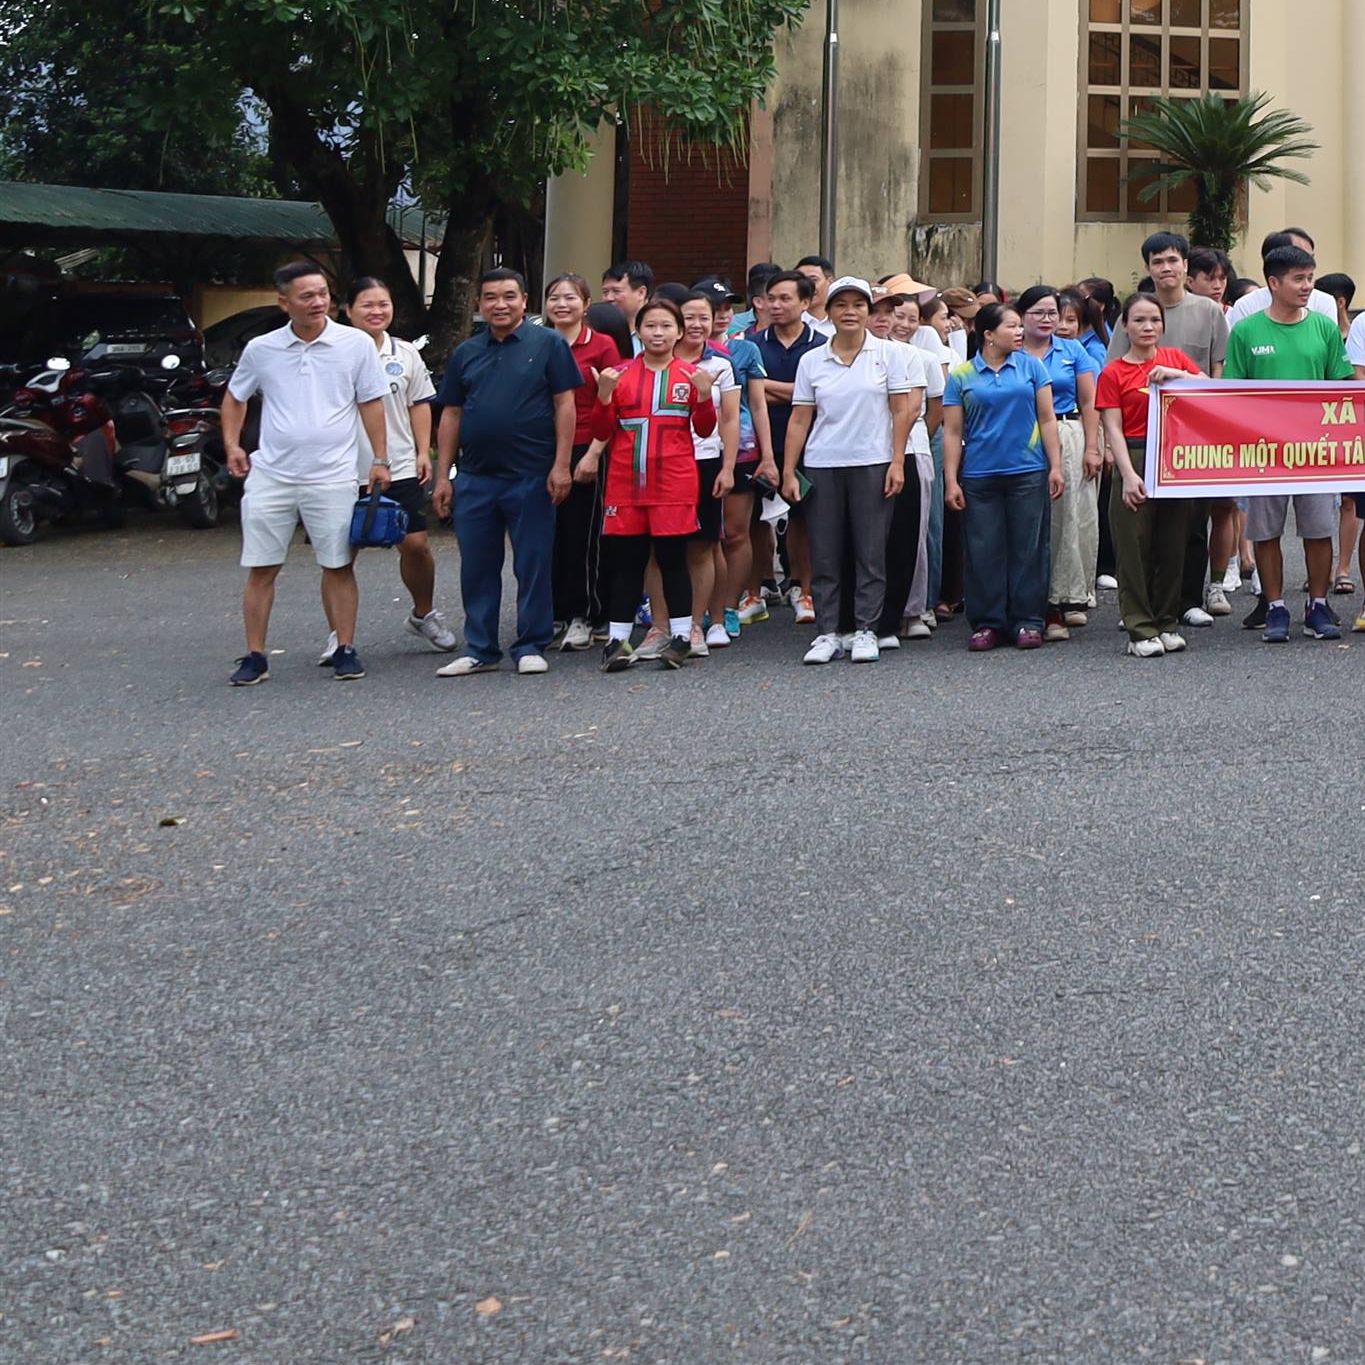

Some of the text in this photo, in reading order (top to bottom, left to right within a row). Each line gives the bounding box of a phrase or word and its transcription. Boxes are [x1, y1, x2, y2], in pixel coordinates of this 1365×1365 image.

[1320, 396, 1357, 425] XÃ
[1172, 443, 1234, 470] CHUNG
[1239, 438, 1278, 474] MỘT
[1282, 432, 1341, 470] QUYẾT
